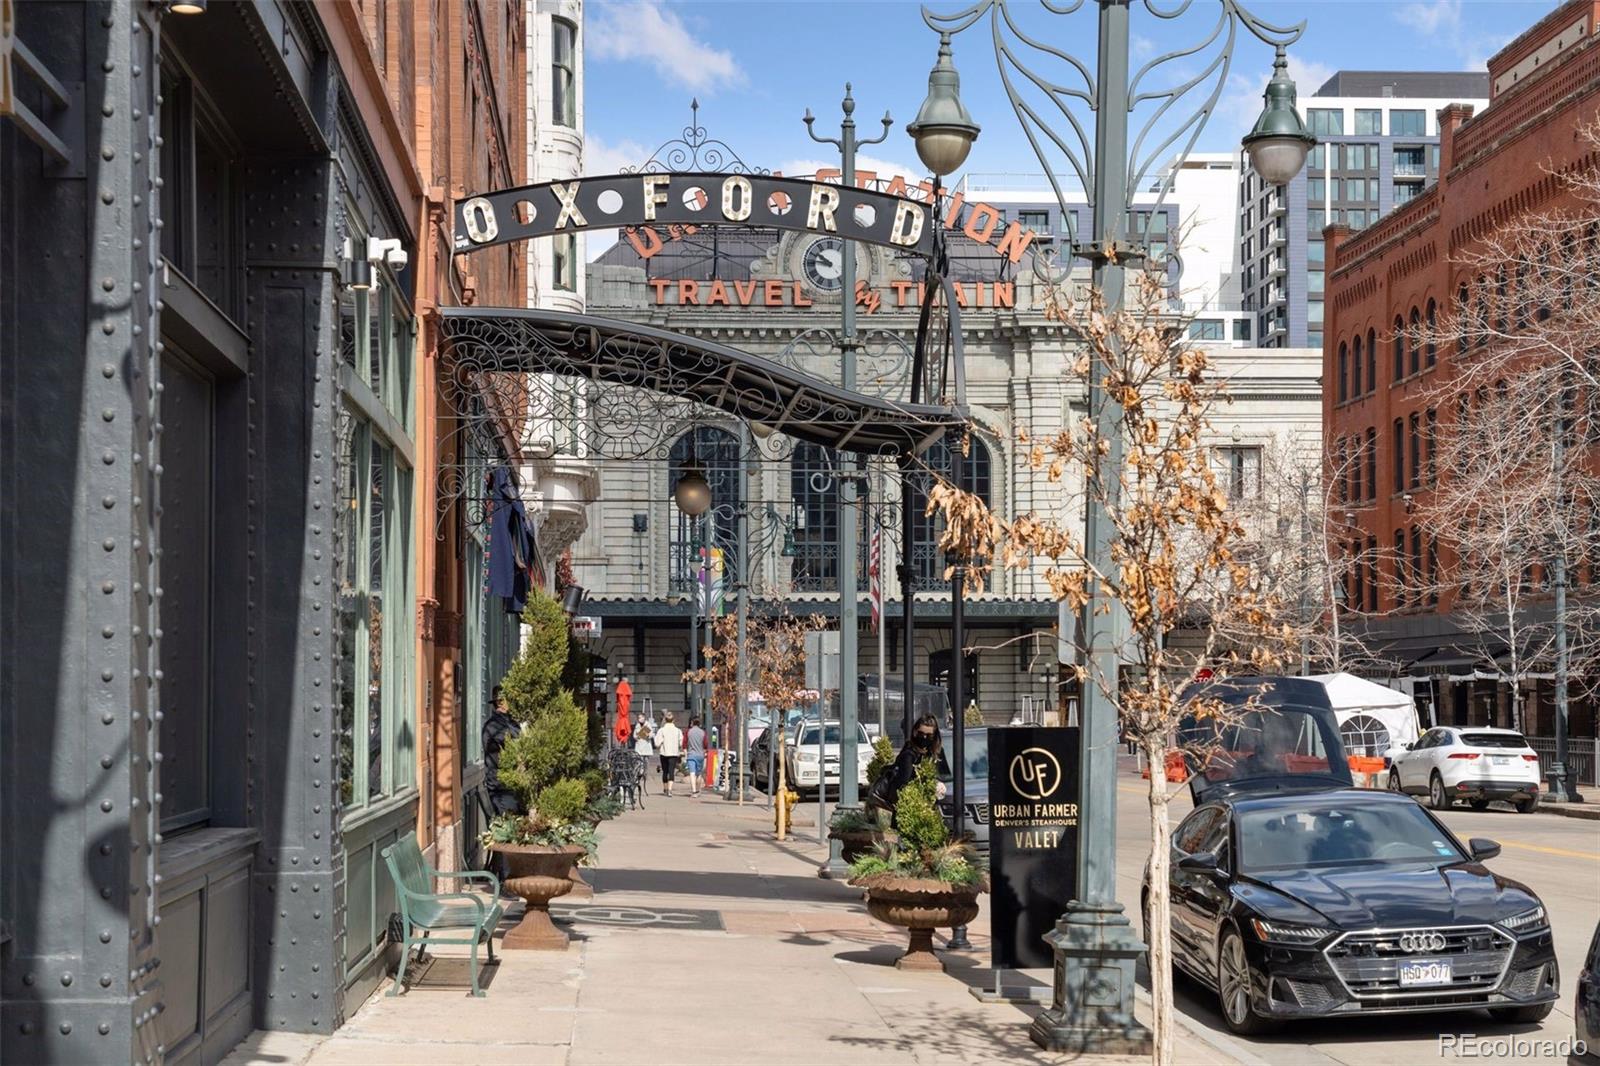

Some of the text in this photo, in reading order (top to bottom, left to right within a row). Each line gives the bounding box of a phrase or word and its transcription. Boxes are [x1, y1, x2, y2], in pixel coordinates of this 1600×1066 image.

[462, 175, 926, 246] OXFORD
[648, 279, 812, 306] TRAVEL
[994, 804, 1078, 818] URBAN FARMER
[995, 818, 1077, 827] DENVER'S STEAKHOUSE
[1014, 831, 1058, 849] VALET
